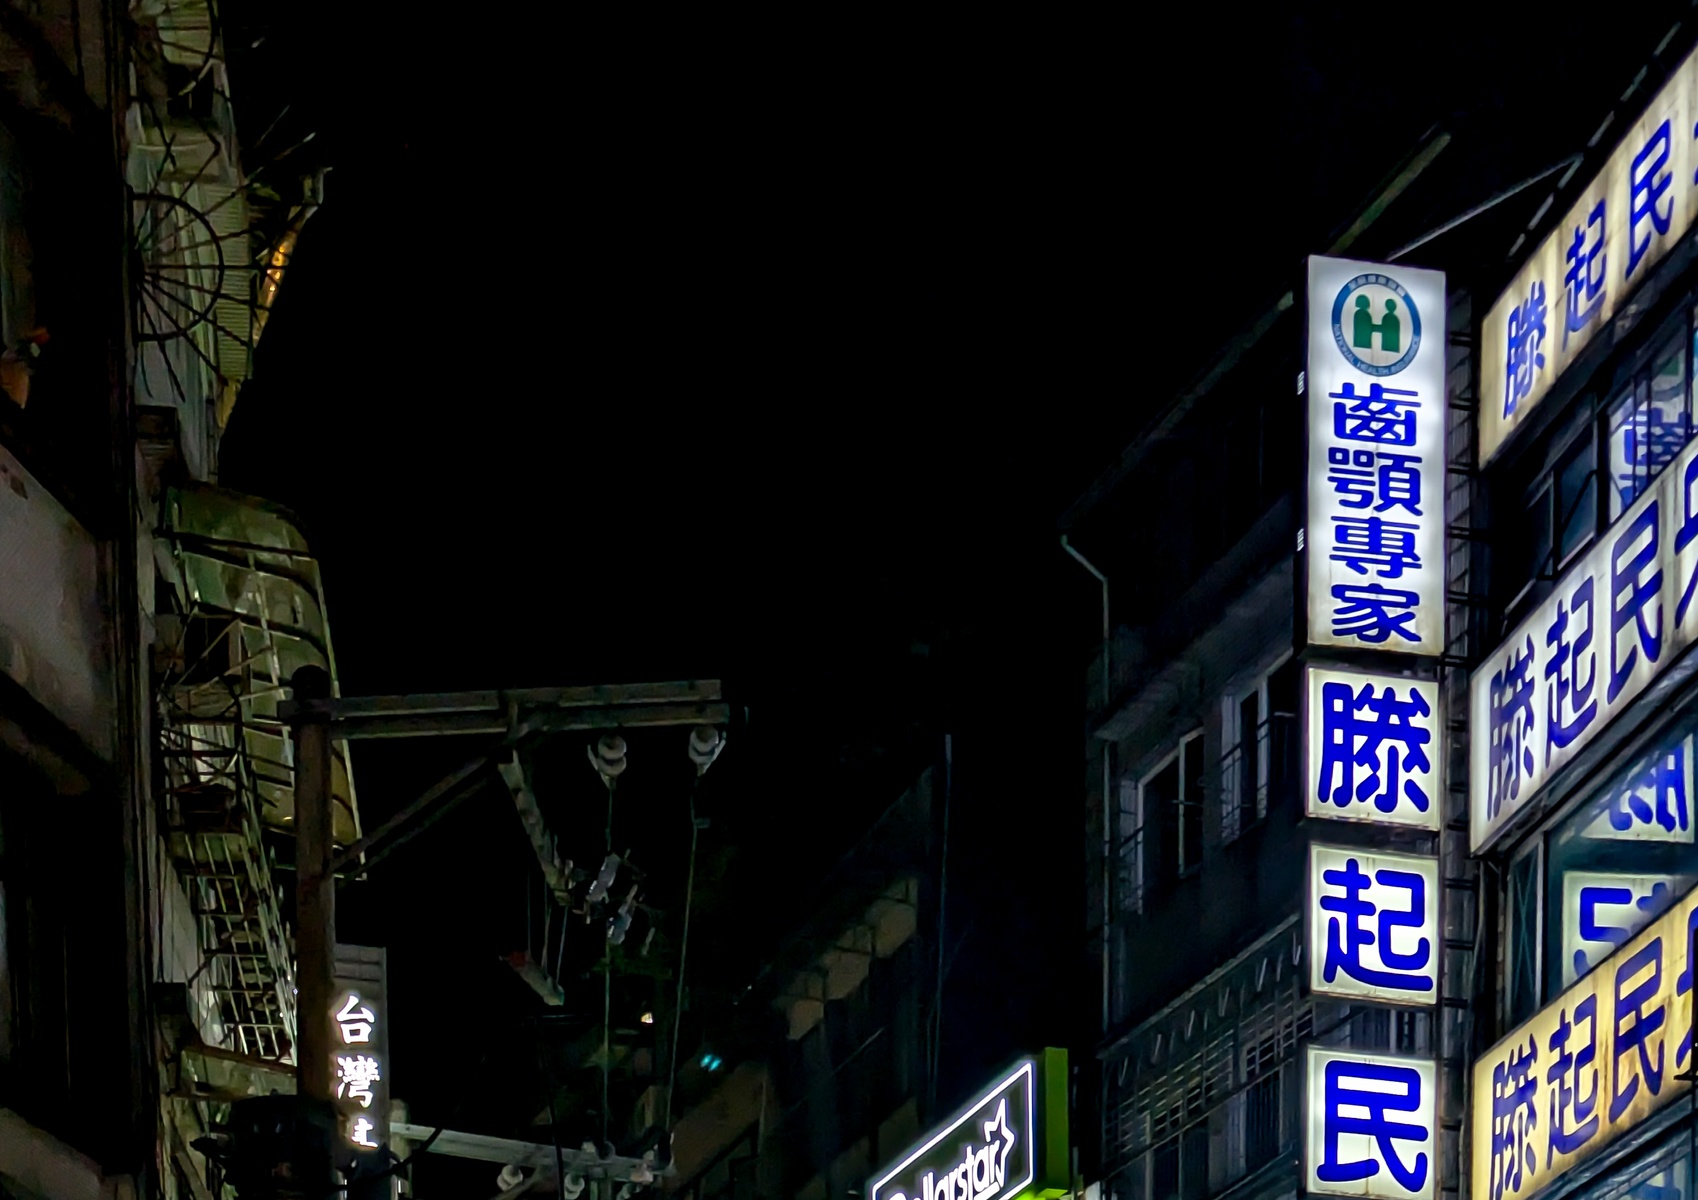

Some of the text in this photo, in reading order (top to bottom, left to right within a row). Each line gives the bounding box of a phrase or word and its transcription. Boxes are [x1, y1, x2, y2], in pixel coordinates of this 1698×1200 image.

[1503, 118, 1698, 420] 滕起民
[1327, 383, 1424, 644] 齒顎專家
